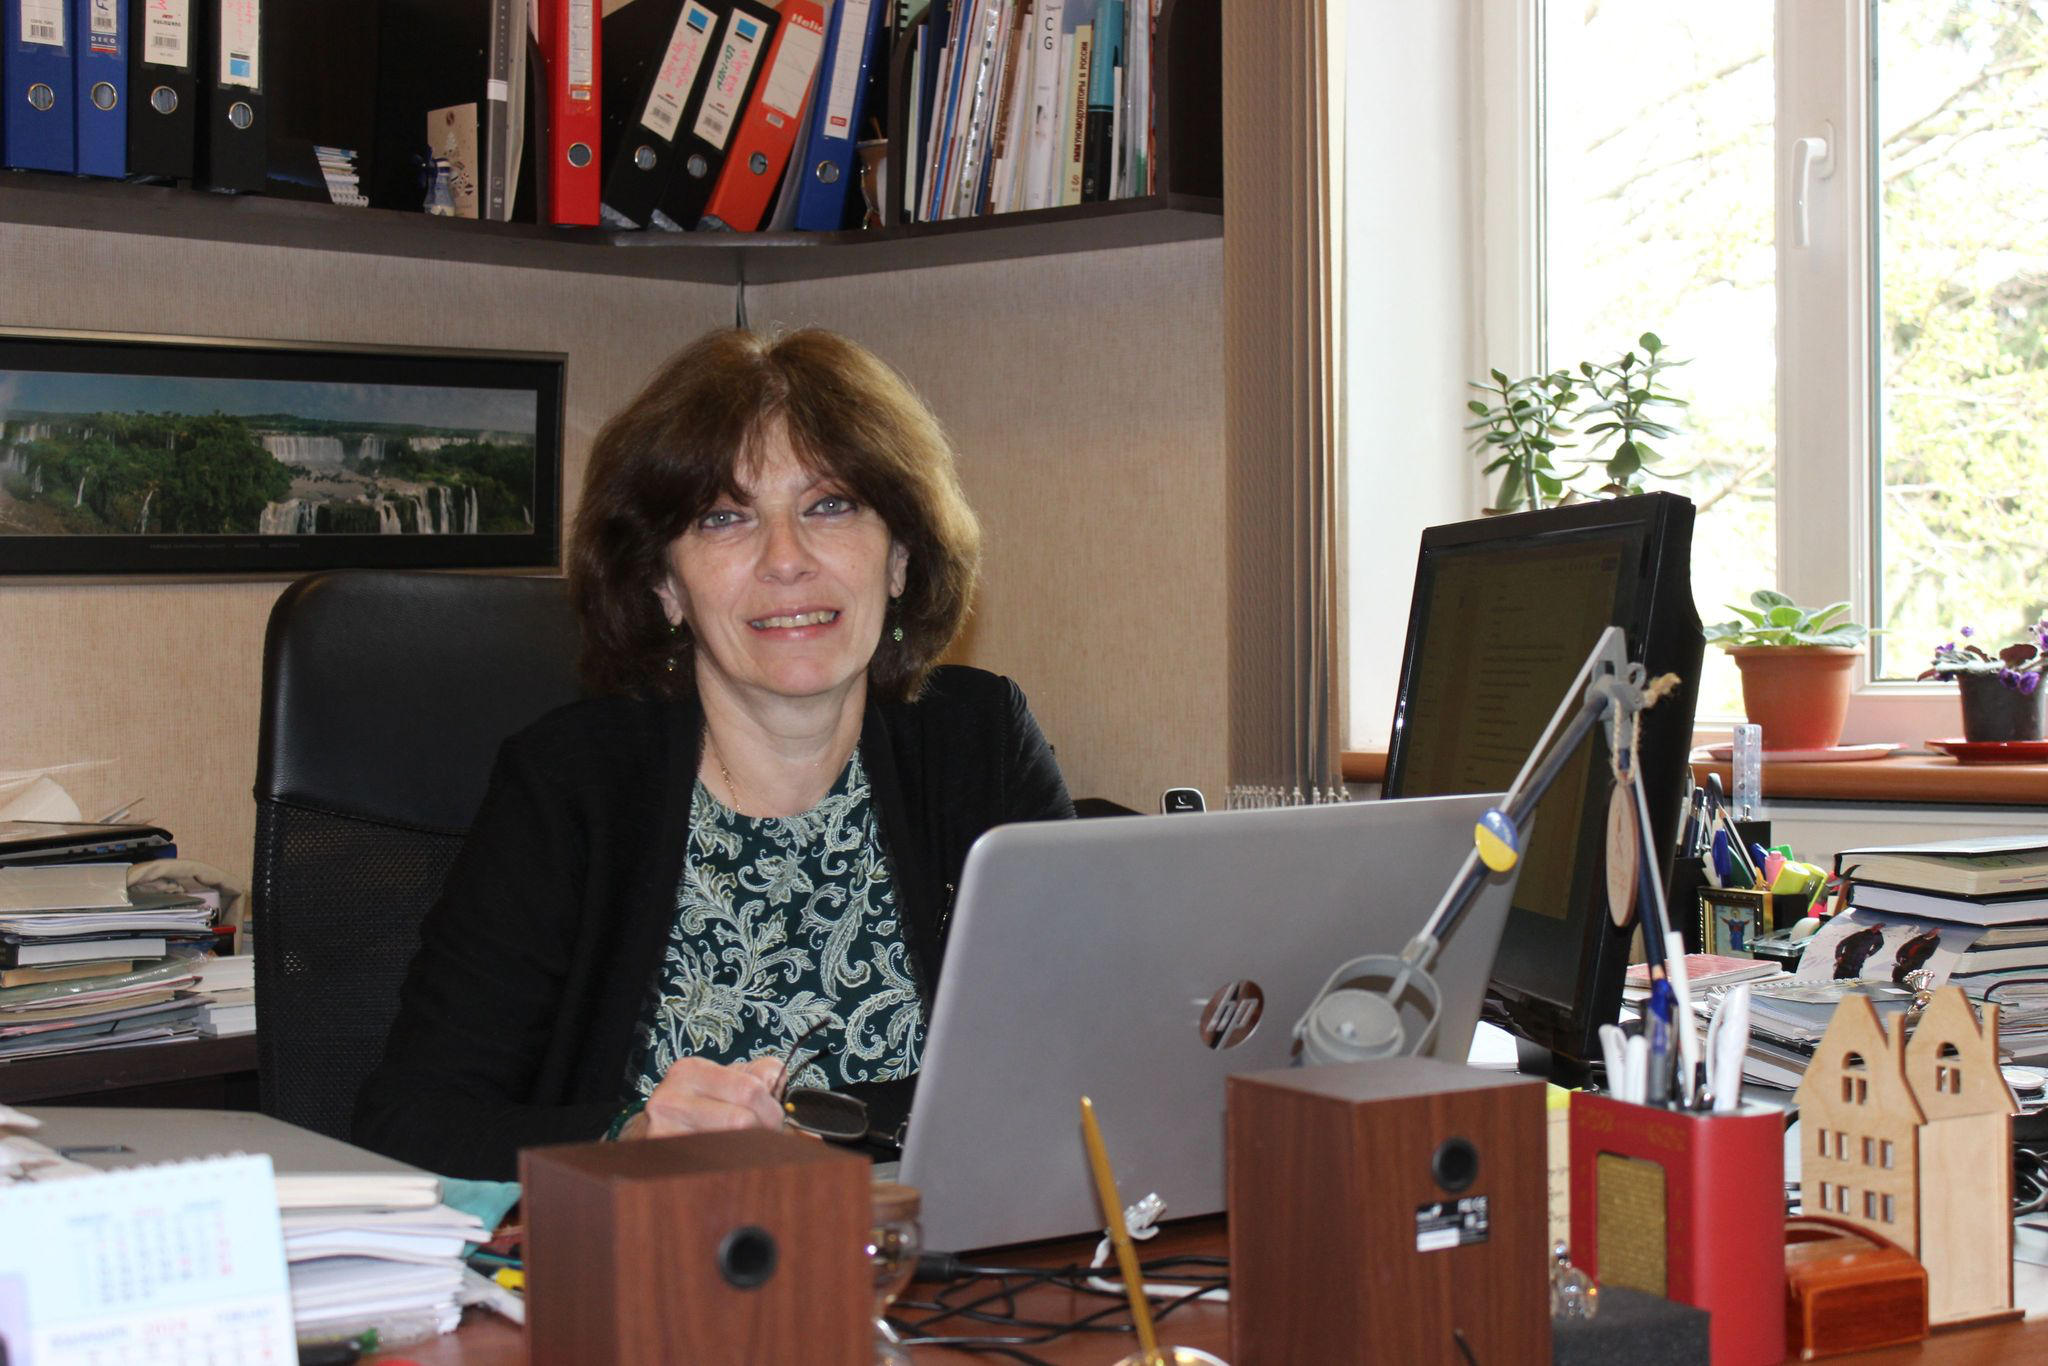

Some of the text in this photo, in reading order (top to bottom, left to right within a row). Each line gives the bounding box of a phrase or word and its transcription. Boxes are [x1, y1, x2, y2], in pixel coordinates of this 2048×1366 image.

[1079, 41, 1088, 70] РОССИИ
[1073, 80, 1086, 163] ИММУНОМОДУЛЯТОРЫ
[1206, 982, 1259, 1051] hp
